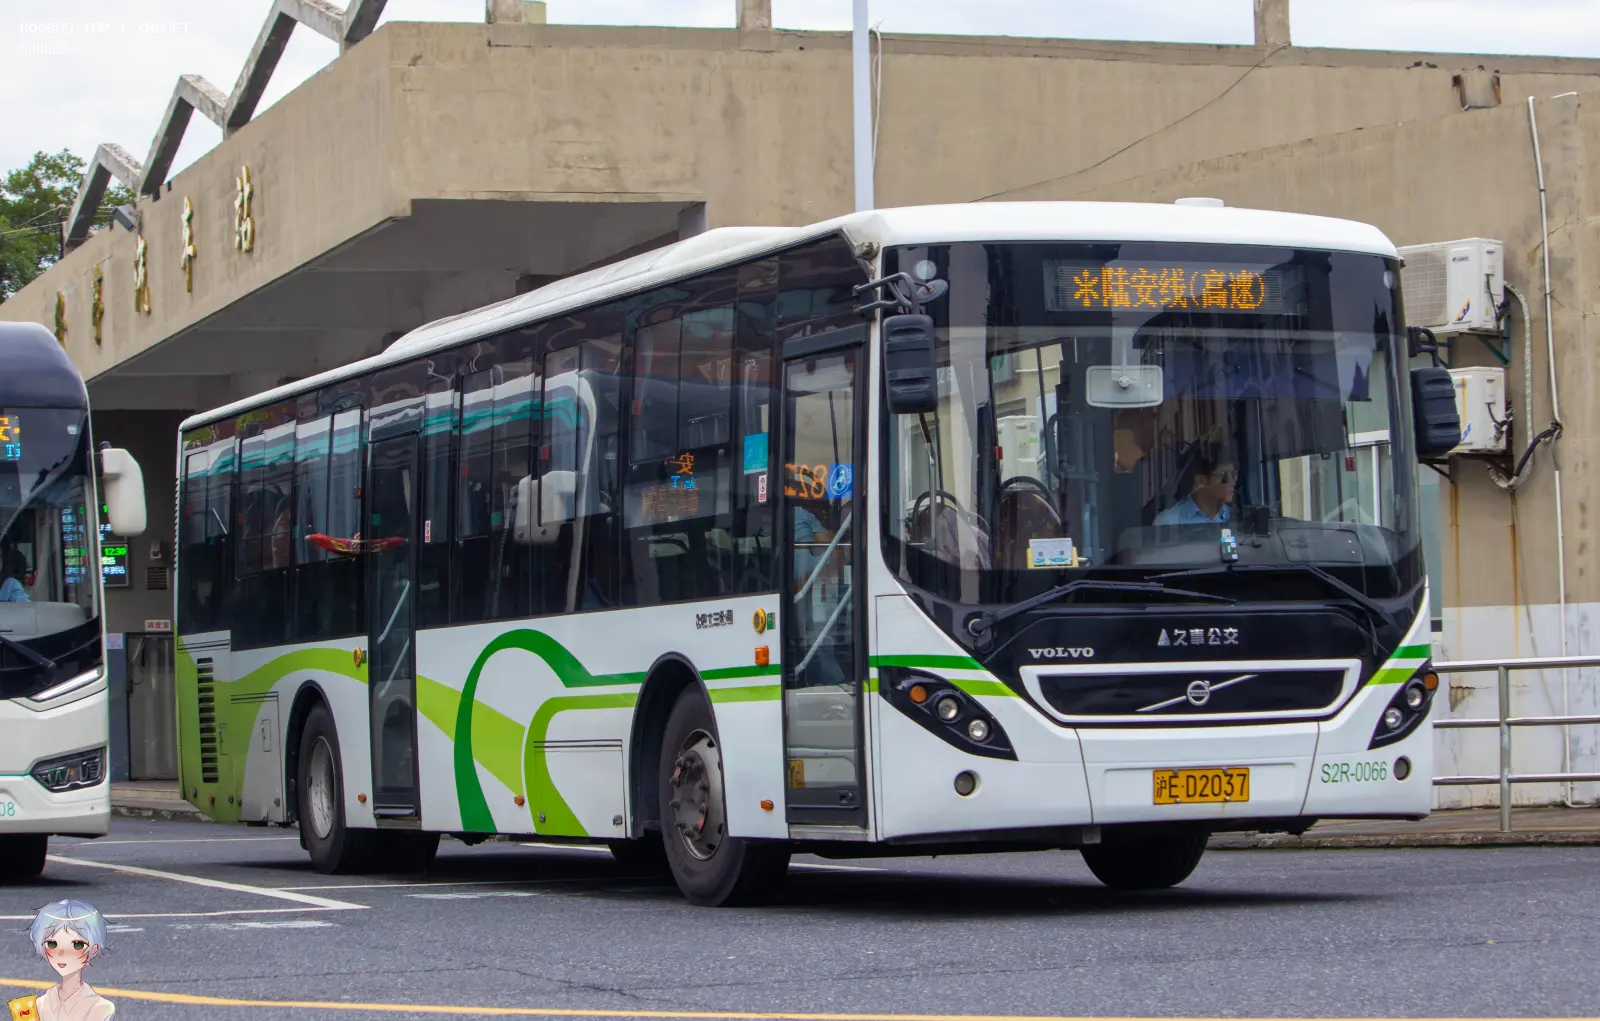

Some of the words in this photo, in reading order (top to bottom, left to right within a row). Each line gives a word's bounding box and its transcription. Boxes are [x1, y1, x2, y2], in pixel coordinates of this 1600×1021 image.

[1173, 627, 1240, 646] 久事公交
[1028, 647, 1095, 659] VOLVO
[1320, 761, 1388, 784] S2R-0066
